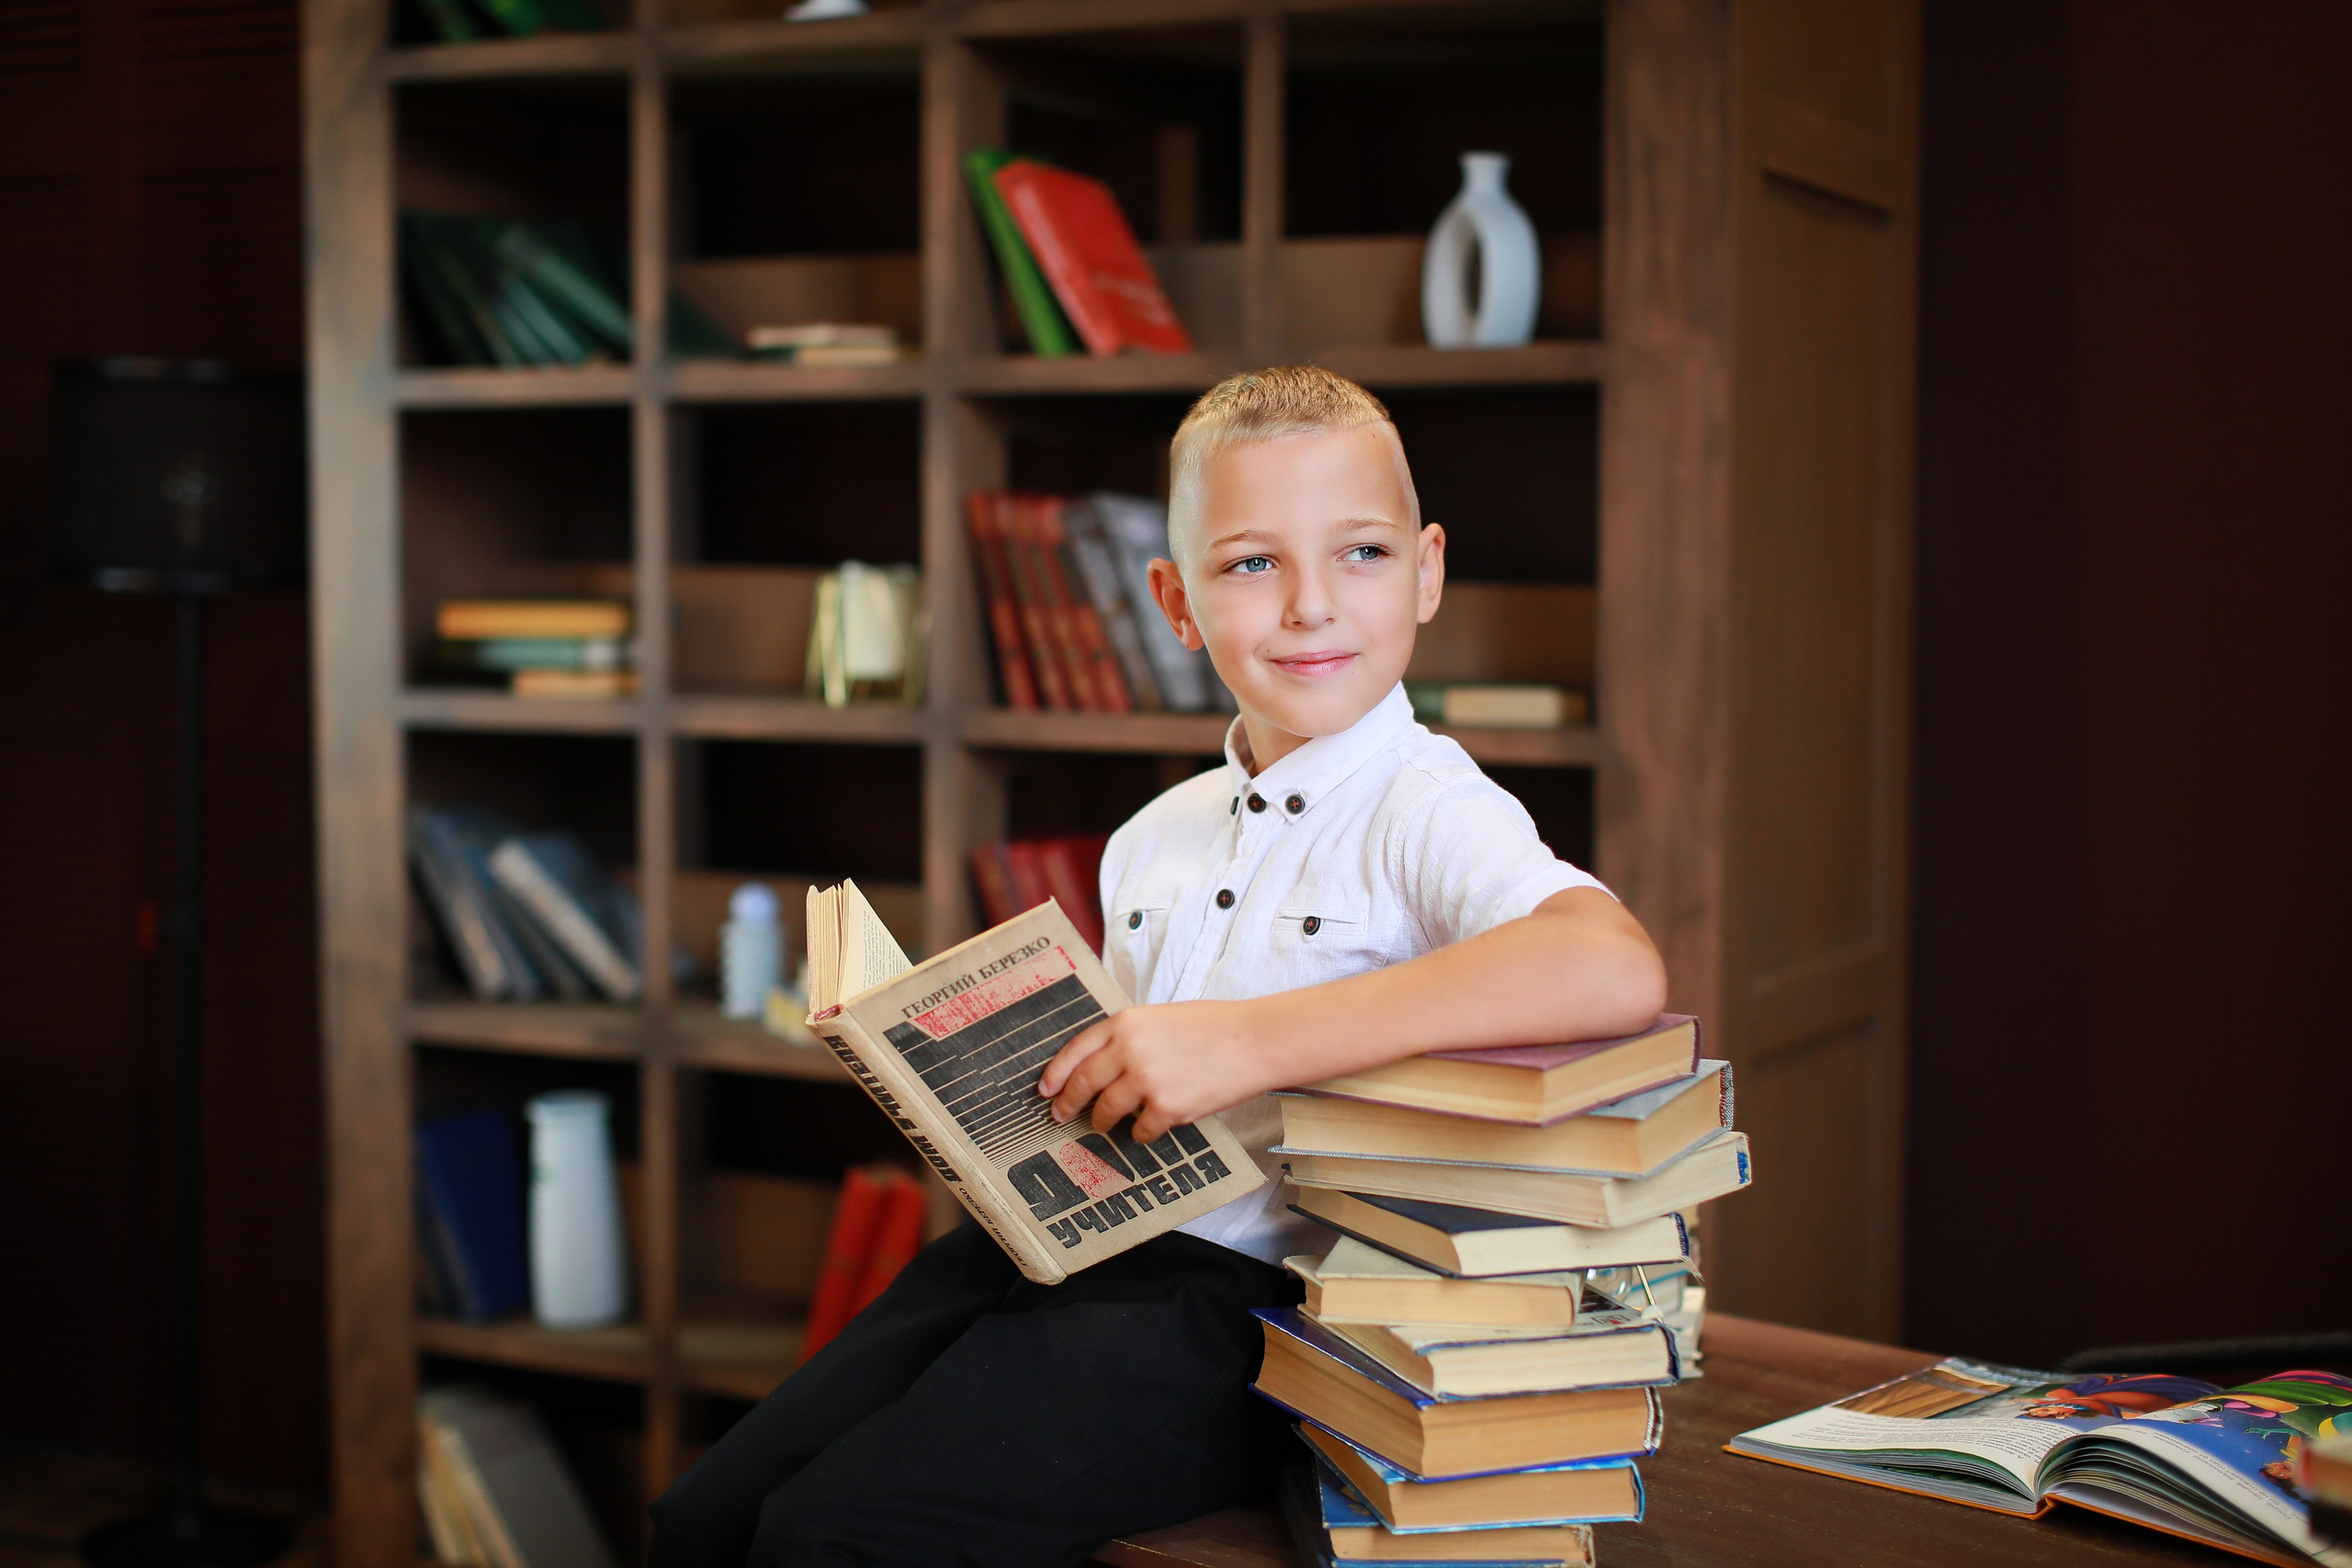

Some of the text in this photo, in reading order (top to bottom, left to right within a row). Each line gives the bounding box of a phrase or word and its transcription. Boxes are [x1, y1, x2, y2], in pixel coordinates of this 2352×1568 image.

[901, 936, 1051, 1019] ГЕОРГИЙ БЕРЕЗКО
[823, 1034, 919, 1131] УЧИТЕЛЯ
[910, 1134, 964, 1183] ДОМ
[958, 1187, 994, 1225] БЕРЕЗКО
[1046, 1149, 1232, 1249] УЧИТЕЛЯ
[991, 1227, 1029, 1268] ГЕОРГИЙ
